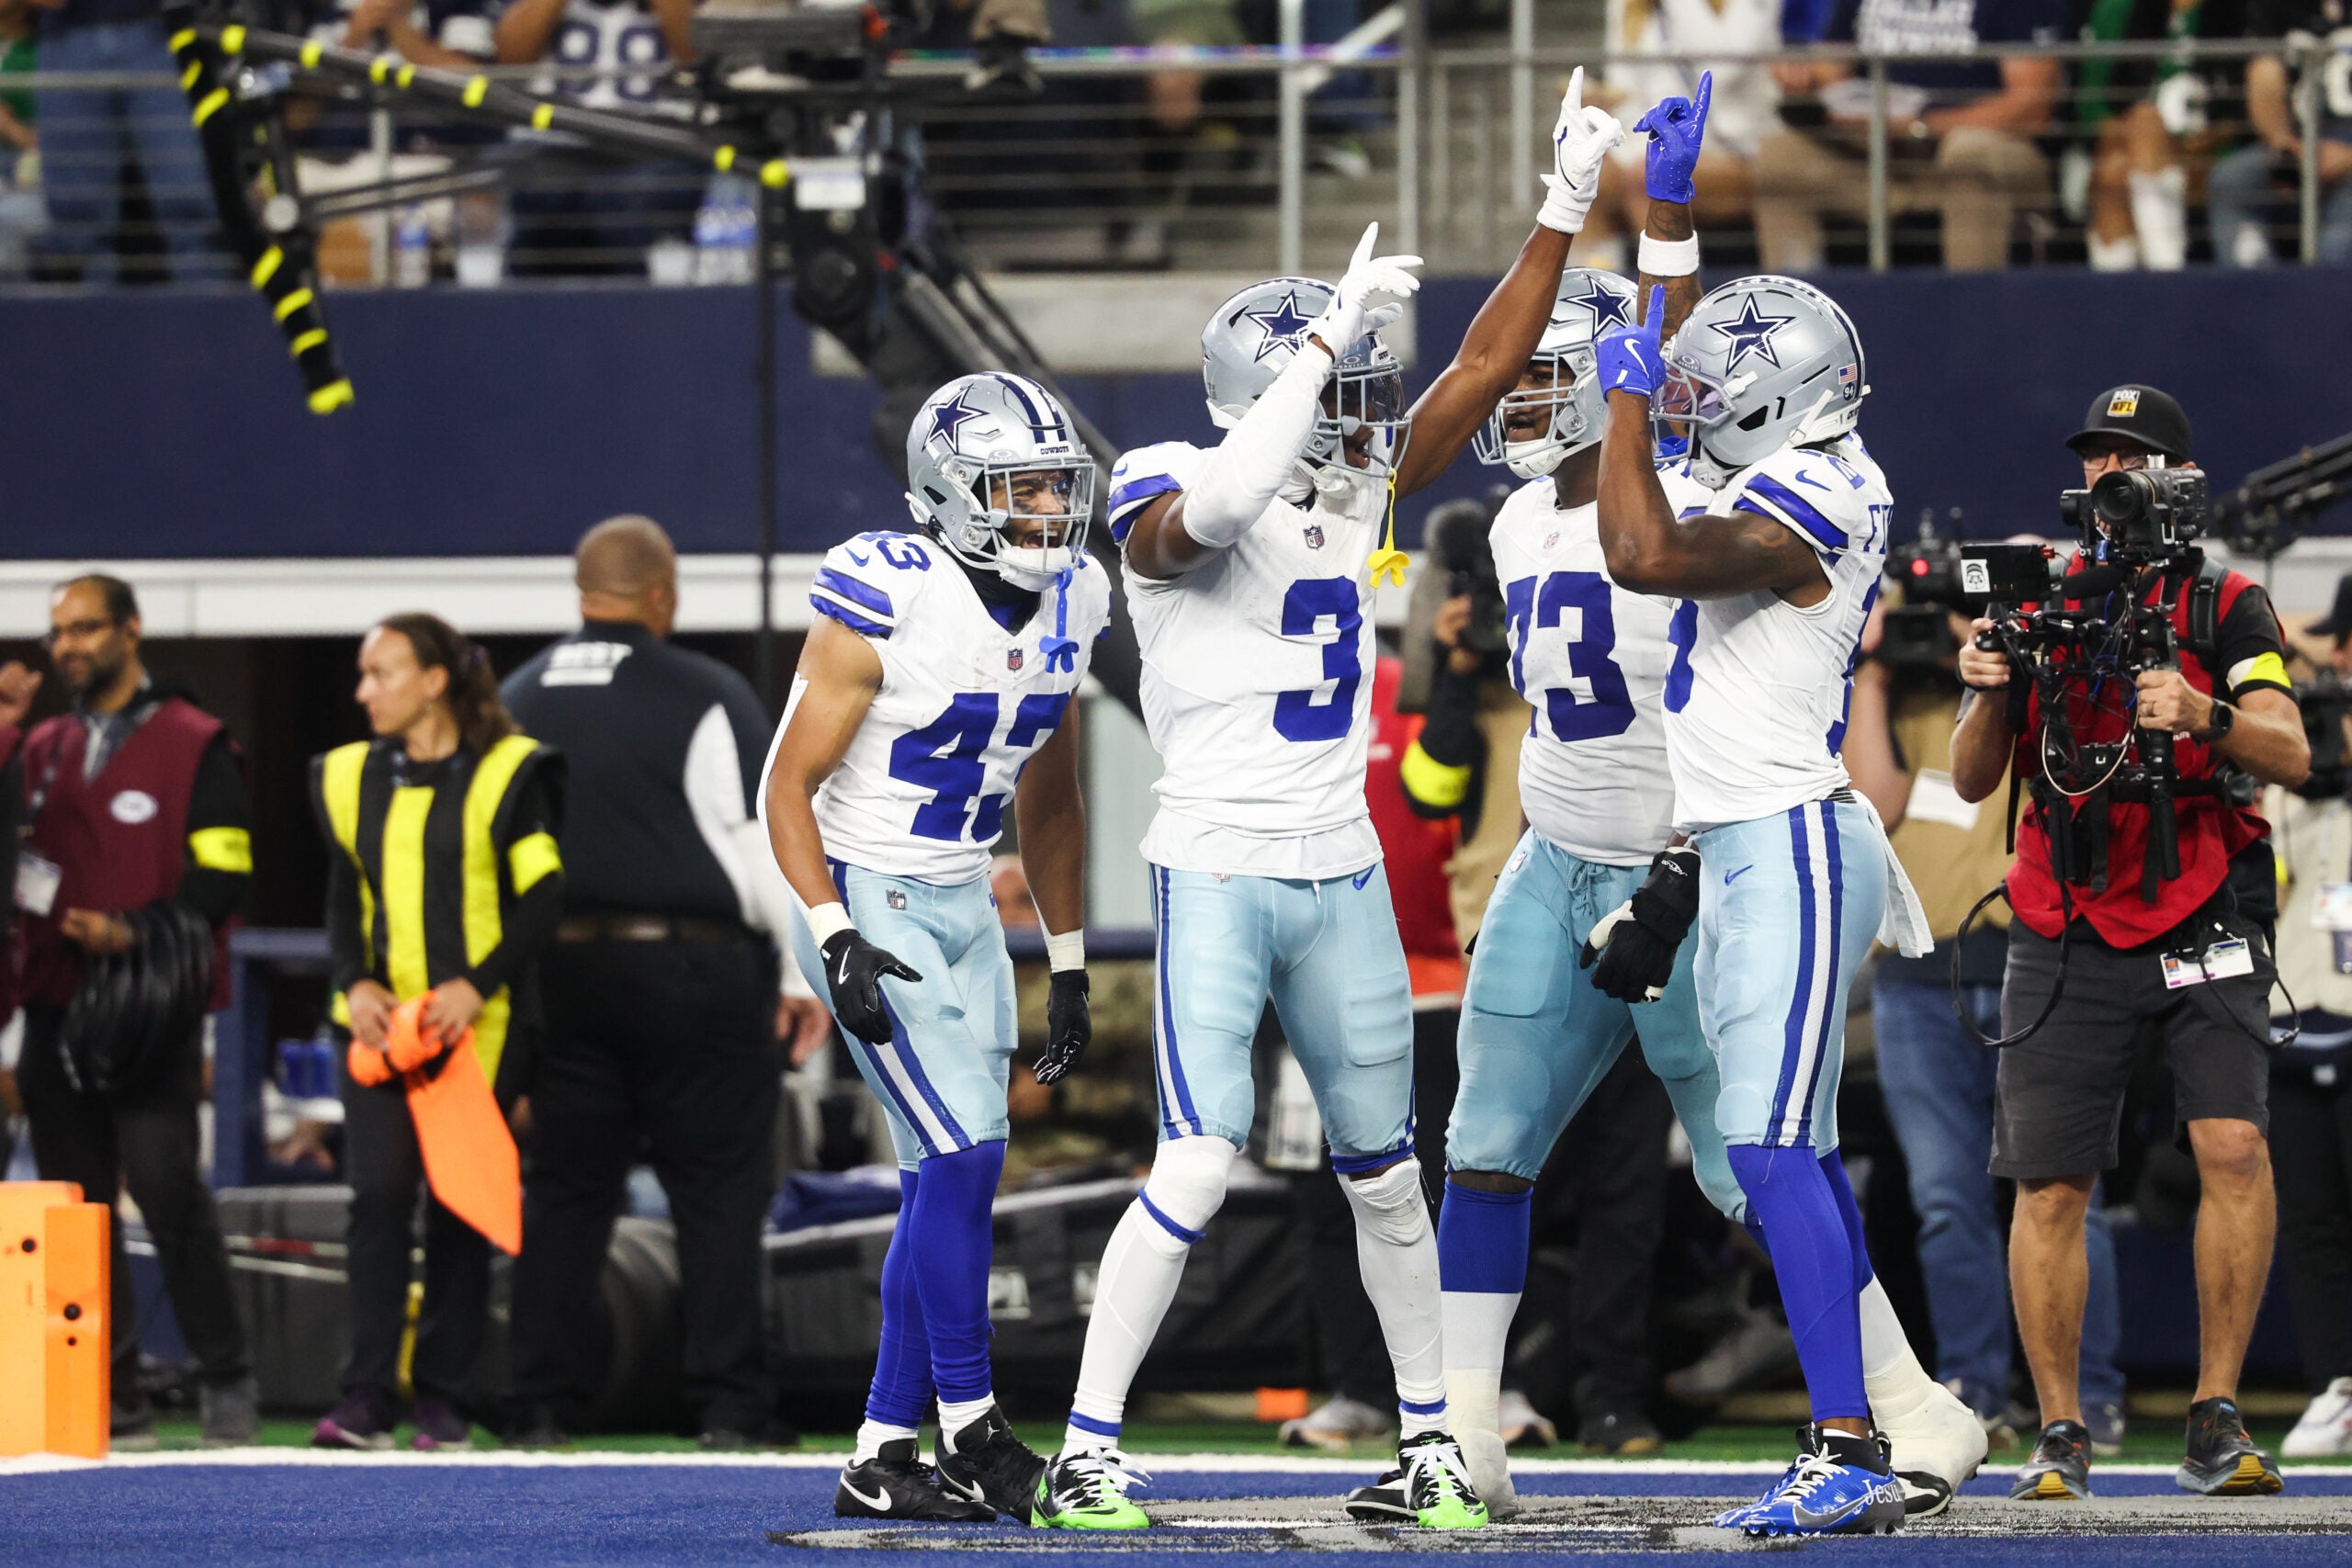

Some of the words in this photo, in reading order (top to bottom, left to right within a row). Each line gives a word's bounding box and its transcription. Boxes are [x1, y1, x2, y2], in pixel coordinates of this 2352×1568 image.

[1844, 386, 1854, 398] 94
[2110, 401, 2133, 412] NFL
[2114, 389, 2139, 400] FOX
[1273, 575, 1363, 742] 3
[1505, 571, 1637, 742] 73
[888, 693, 1070, 843] 43
